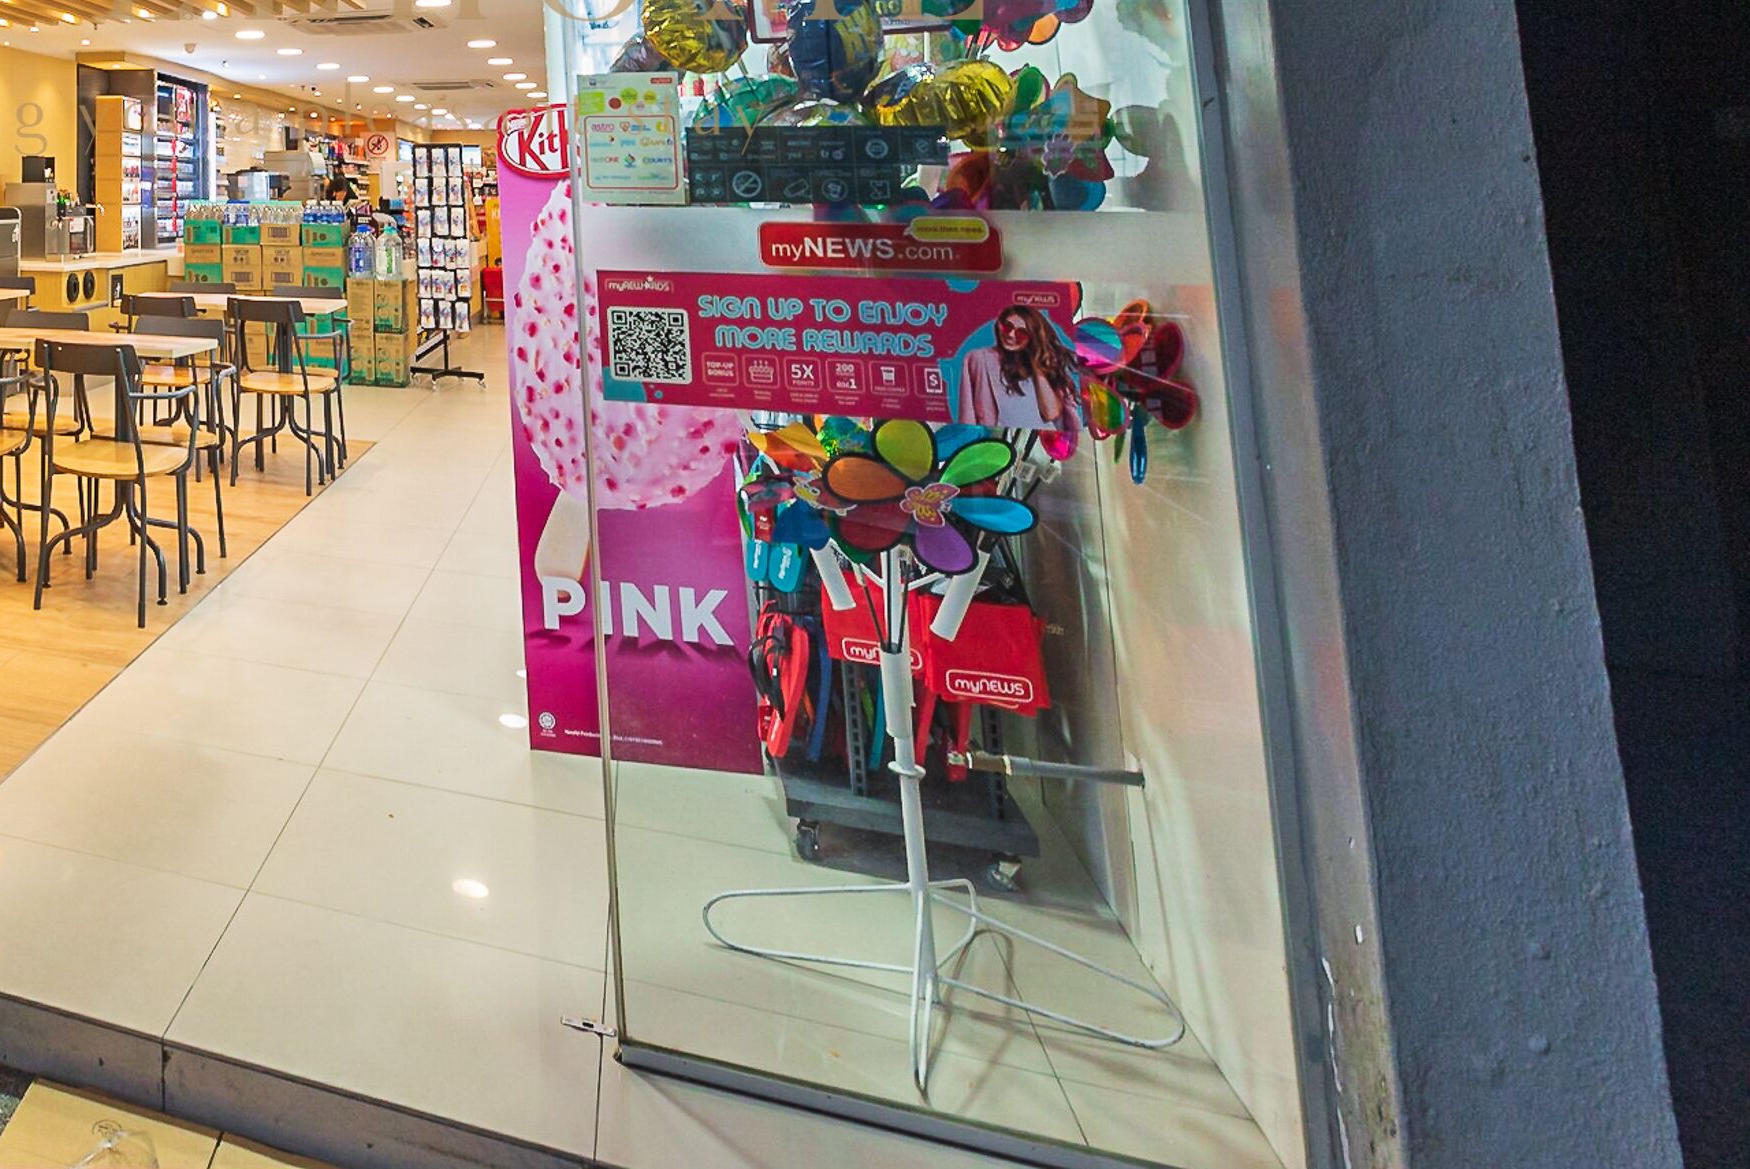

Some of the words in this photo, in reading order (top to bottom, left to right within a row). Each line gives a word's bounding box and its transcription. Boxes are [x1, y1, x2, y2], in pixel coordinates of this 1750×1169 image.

[771, 236, 954, 261] myNEWS.com
[768, 297, 804, 322] UP
[810, 299, 852, 322] TO
[858, 300, 948, 327] ENJOY
[715, 324, 797, 350] MORE
[803, 329, 935, 357] REWARDS
[791, 363, 815, 380] 5X
[541, 575, 735, 647] PINK
